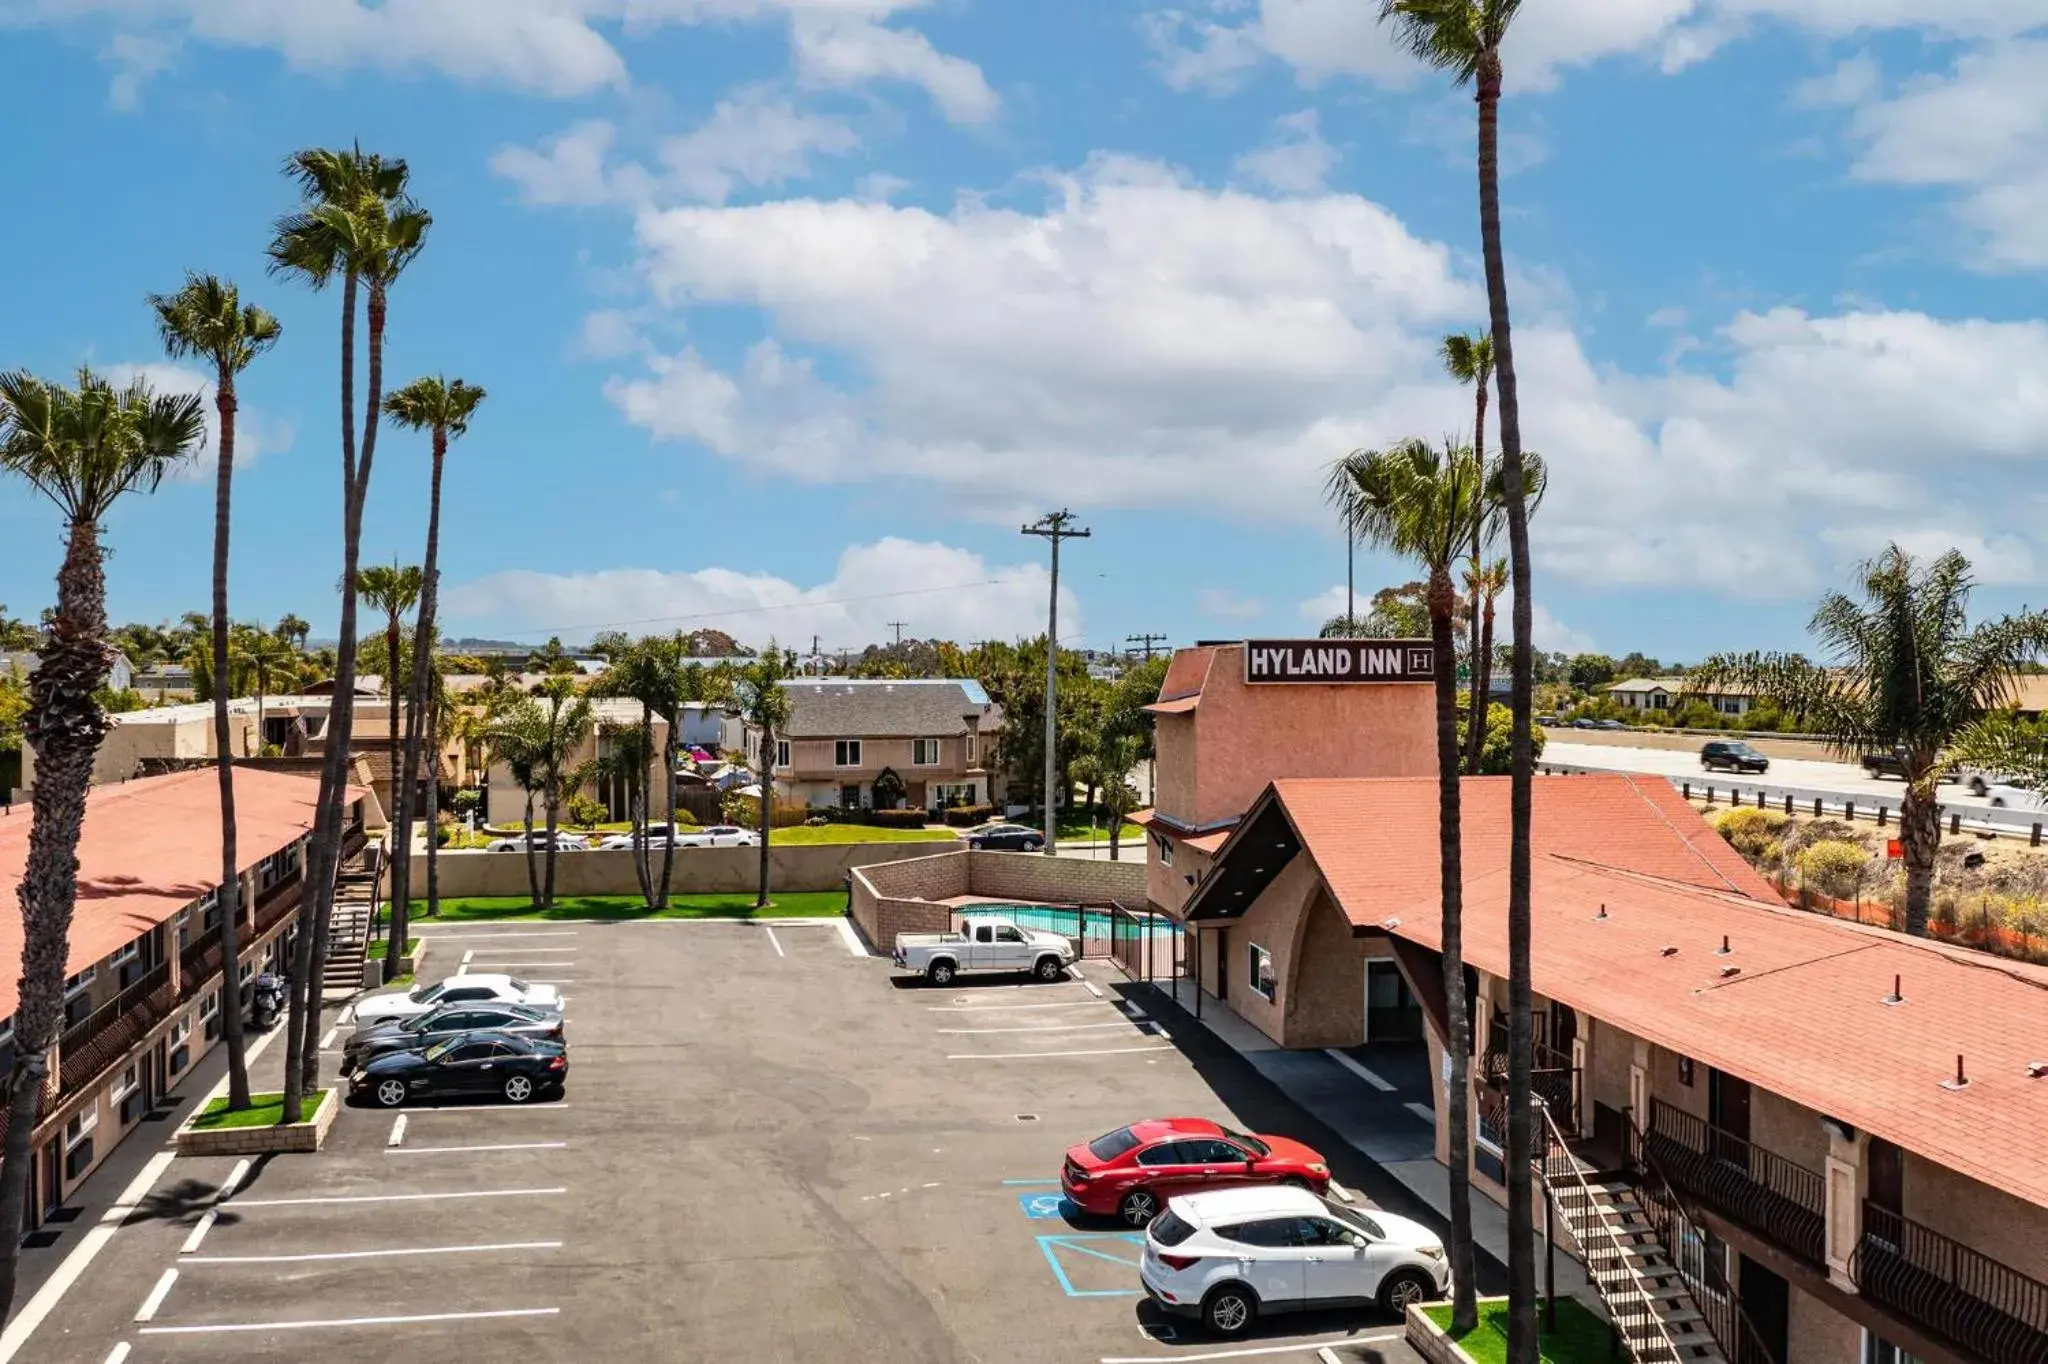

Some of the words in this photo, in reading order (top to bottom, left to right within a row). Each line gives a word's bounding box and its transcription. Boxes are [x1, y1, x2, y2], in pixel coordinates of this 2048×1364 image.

[1251, 648, 1351, 675] HYLAND
[1360, 648, 1402, 675] INN
[1412, 653, 1430, 669] H
